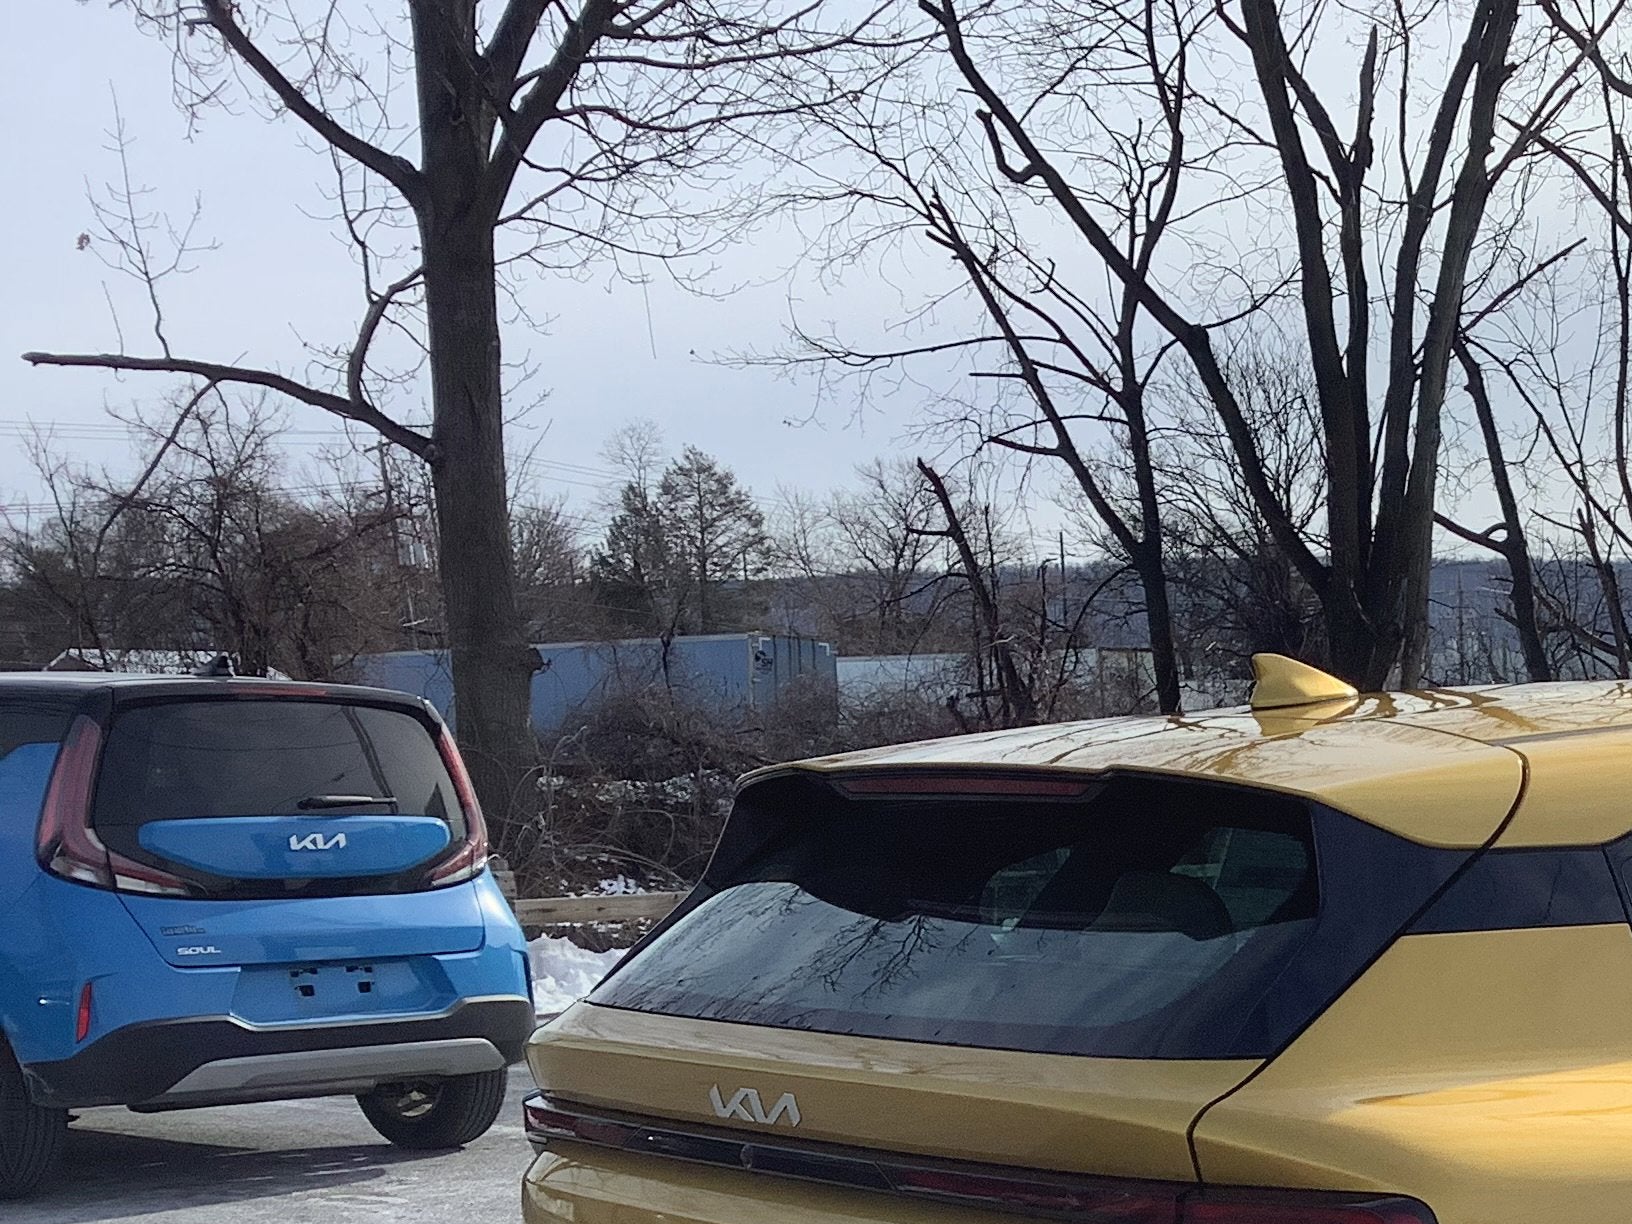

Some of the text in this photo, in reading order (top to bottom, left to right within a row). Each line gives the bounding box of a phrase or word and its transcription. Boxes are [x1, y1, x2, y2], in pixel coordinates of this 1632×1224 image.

[289, 832, 347, 850] KIA
[177, 945, 222, 956] SOUL
[708, 1082, 802, 1128] KIA
